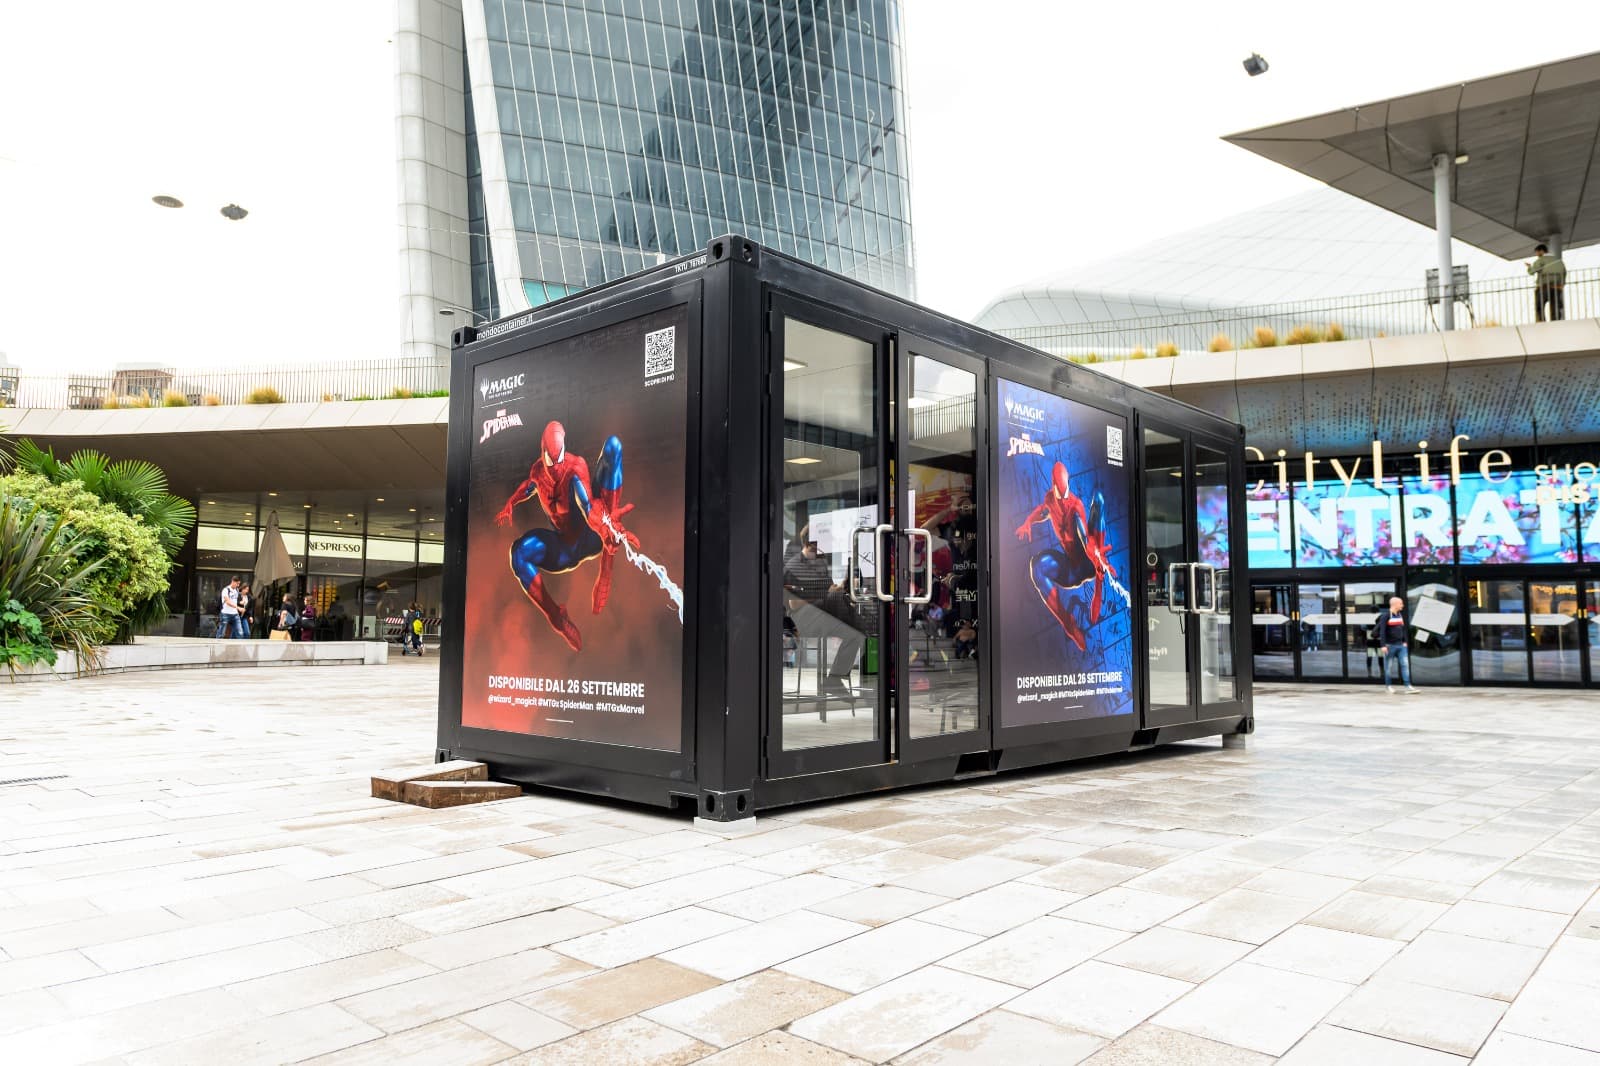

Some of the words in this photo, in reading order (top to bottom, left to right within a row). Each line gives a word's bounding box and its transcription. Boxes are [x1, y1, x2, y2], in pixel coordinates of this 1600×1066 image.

[476, 313, 533, 341] mondocontainer.it
[488, 373, 525, 394] MAGIC
[1013, 402, 1045, 421] MAGIC
[479, 413, 524, 444] SPIDER-MAN
[1534, 461, 1600, 484] SHO
[309, 540, 361, 553] NESPRESSO
[488, 675, 544, 692] DISPONIBILE
[545, 678, 566, 693] DAL
[567, 679, 580, 694] 26
[581, 680, 645, 698] SETTEMBRE
[1017, 674, 1062, 689] DISPONIBILE
[1063, 674, 1077, 686] DAL
[1077, 673, 1086, 685] 26
[1086, 671, 1122, 684] SETTEMBRE
[596, 702, 645, 715] #MTGxMarvel
